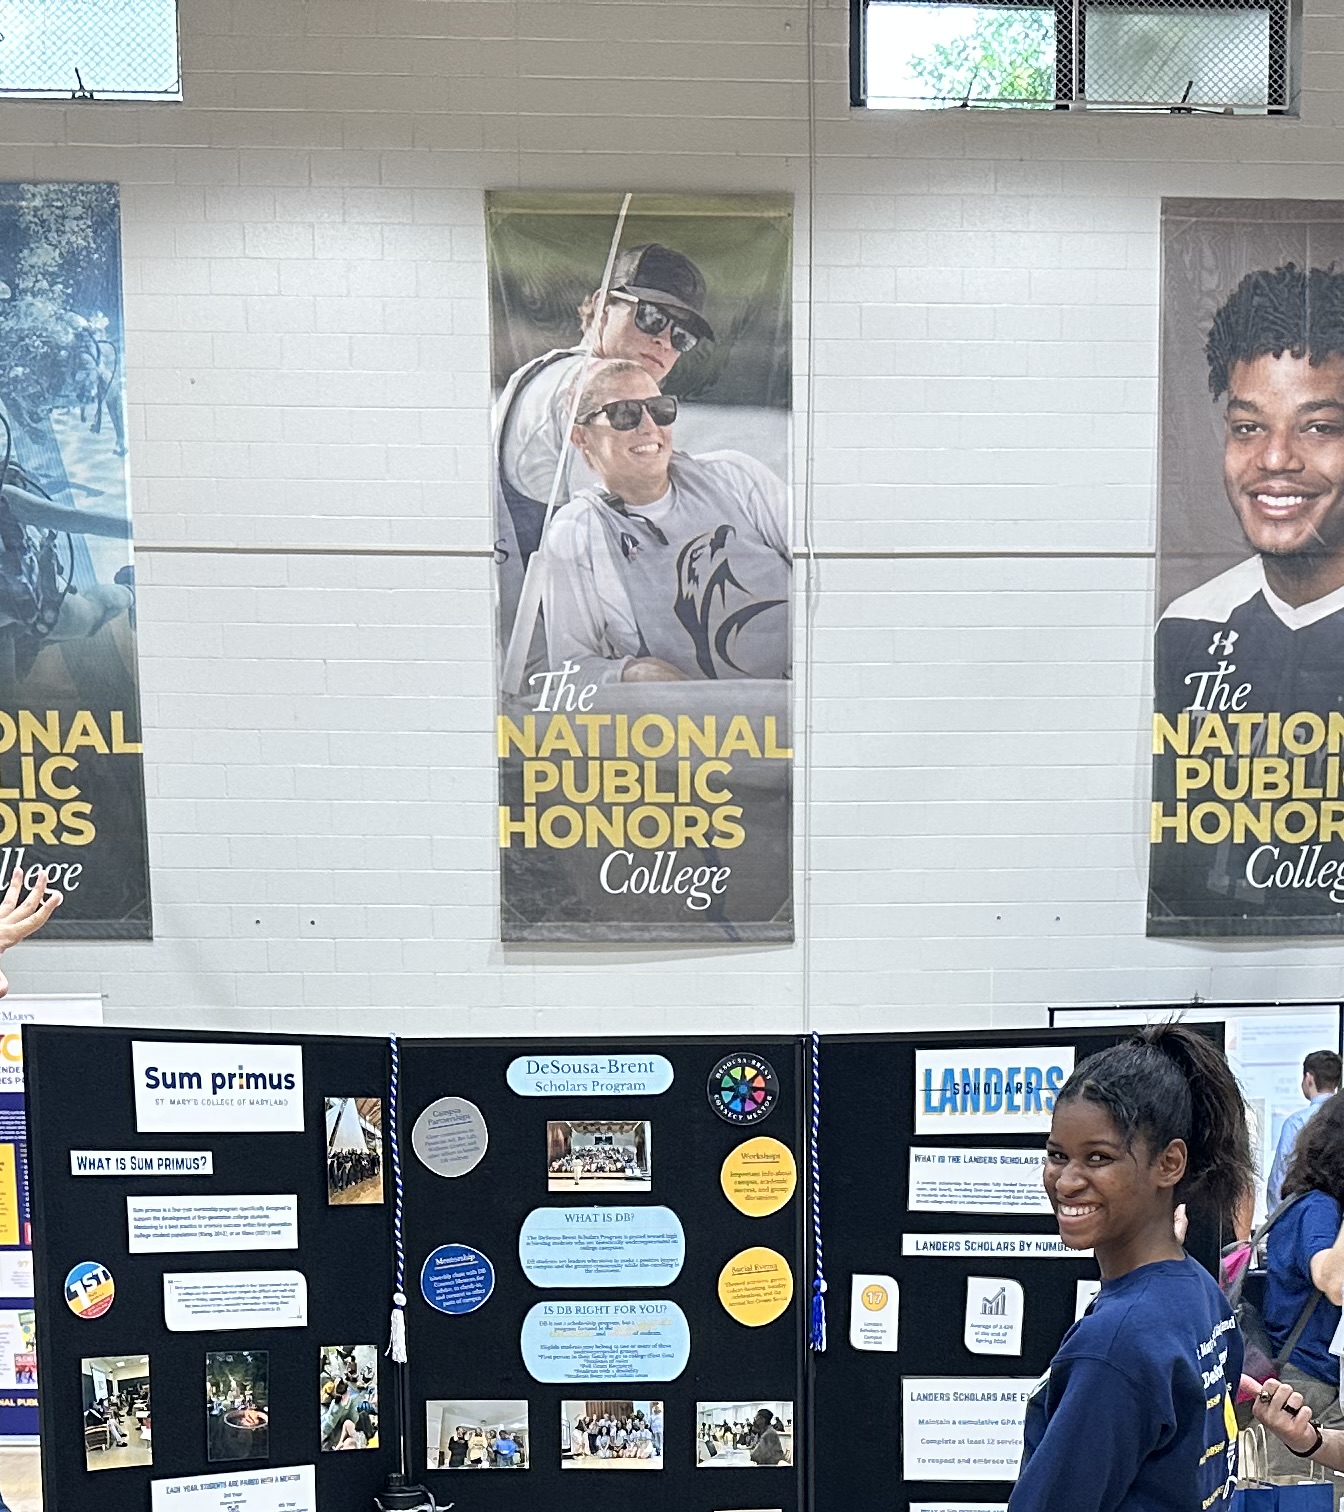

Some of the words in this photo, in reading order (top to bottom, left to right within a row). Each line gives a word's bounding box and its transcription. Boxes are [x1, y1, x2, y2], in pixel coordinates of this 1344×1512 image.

[528, 660, 598, 712] The
[1184, 660, 1252, 711] The
[497, 714, 793, 758] NATIONAL
[523, 760, 734, 804] PUBLIC
[499, 805, 746, 849] HONORS
[600, 850, 731, 910] College
[145, 1067, 202, 1090] Sum
[211, 1065, 295, 1095] primus
[526, 1059, 655, 1075] DeSousa-Brent
[535, 1080, 588, 1092] Scholars
[591, 1081, 646, 1094] Program
[923, 1066, 1063, 1114] LANDERS
[952, 1082, 1033, 1096] SCHOLARS
[565, 1213, 599, 1222] WHAT
[602, 1213, 613, 1222] IS
[615, 1213, 635, 1222] DB?
[544, 1305, 554, 1314] IS
[557, 1305, 572, 1314] DB
[575, 1305, 610, 1314] RIGHT
[614, 1305, 636, 1314] FOR
[638, 1304, 667, 1314] YOU?
[867, 1292, 884, 1304] 17
[910, 1392, 950, 1401] LANDERS
[953, 1392, 997, 1401] SCHOLARS
[1000, 1393, 1017, 1401] ARE
